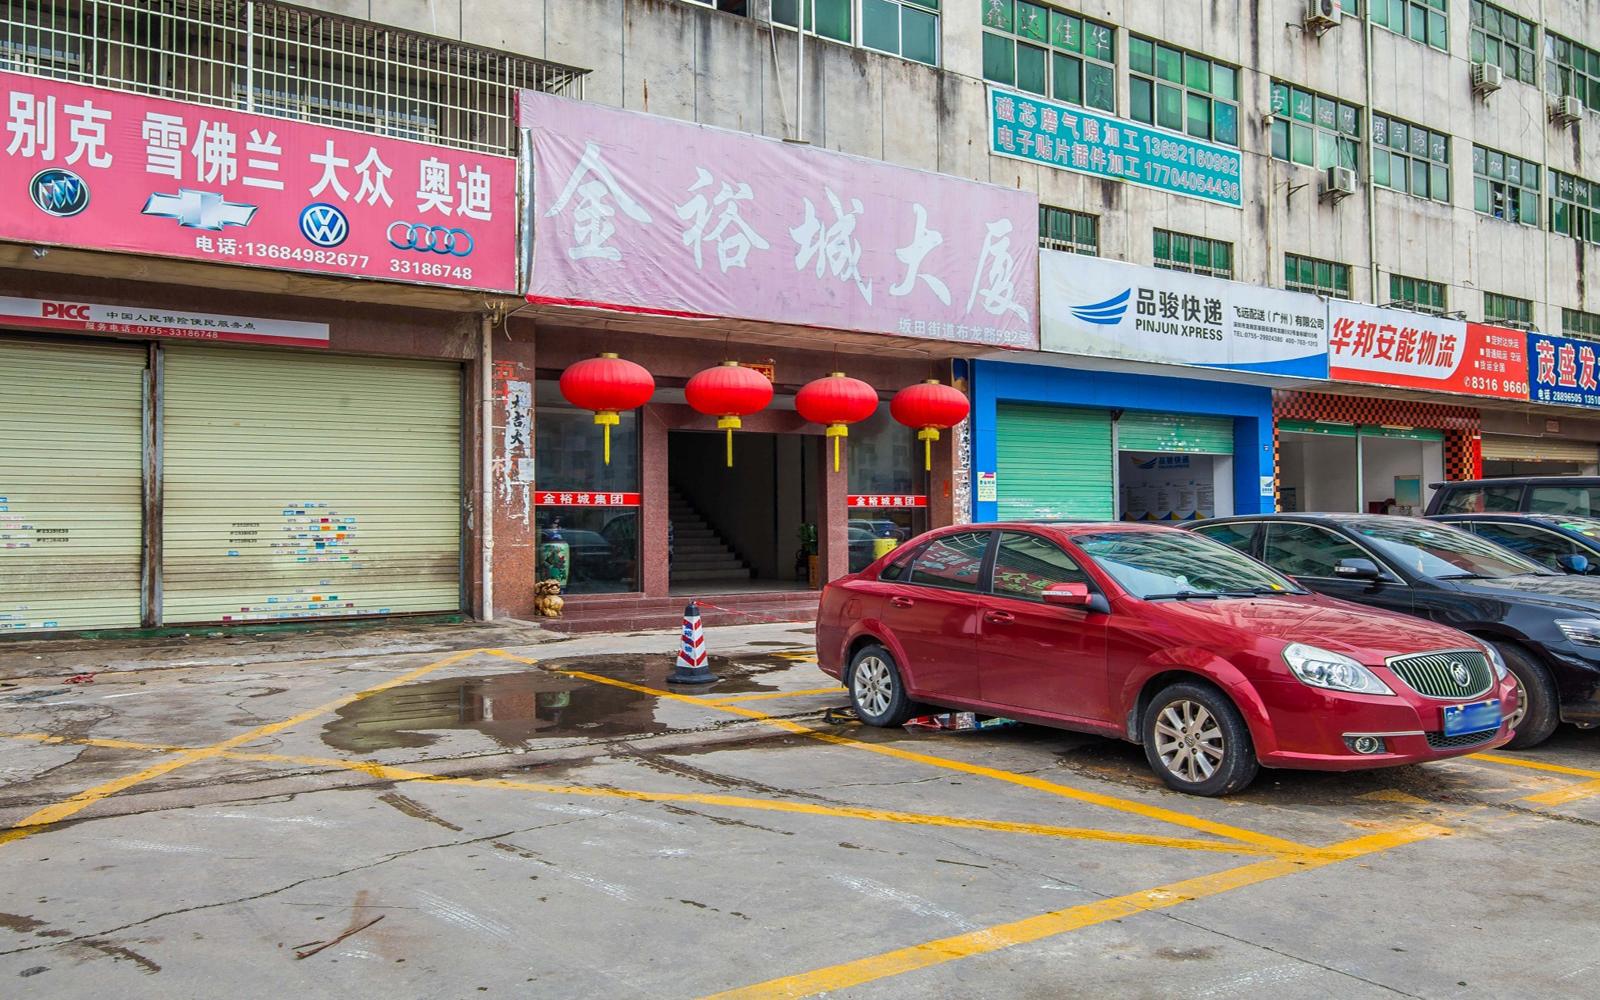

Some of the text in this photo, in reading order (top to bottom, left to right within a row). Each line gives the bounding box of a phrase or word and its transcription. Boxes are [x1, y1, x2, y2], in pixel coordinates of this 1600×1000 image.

[995, 96, 1239, 176] 磁芯磨气隙加工 13692160992
[6, 91, 494, 222] 别克 雪佛兰 大众 奥迪
[997, 125, 1240, 200] 电子贴片插件加工 17704054436
[544, 140, 1030, 324] 金裕城大厦
[195, 236, 370, 270] 电话:13684982677
[389, 258, 473, 281] 33186748
[42, 302, 91, 321] PICC
[1136, 287, 1223, 327] 品骏快递
[84, 321, 219, 339] 服务电话:0755-33186748
[106, 311, 257, 330] 中国人民保险便民服务点
[1135, 318, 1224, 342] PINJUN XPRESS
[1329, 317, 1458, 368] 华邦安能物流
[1480, 360, 1506, 373] 货运全国
[1535, 339, 1600, 391] 茂盛发
[1471, 376, 1528, 395] 8316 9660
[1537, 389, 1551, 400] 电话
[1552, 391, 1583, 403] 28896505
[542, 493, 624, 505] 金裕城集团
[855, 496, 915, 506] 金裕城集团
